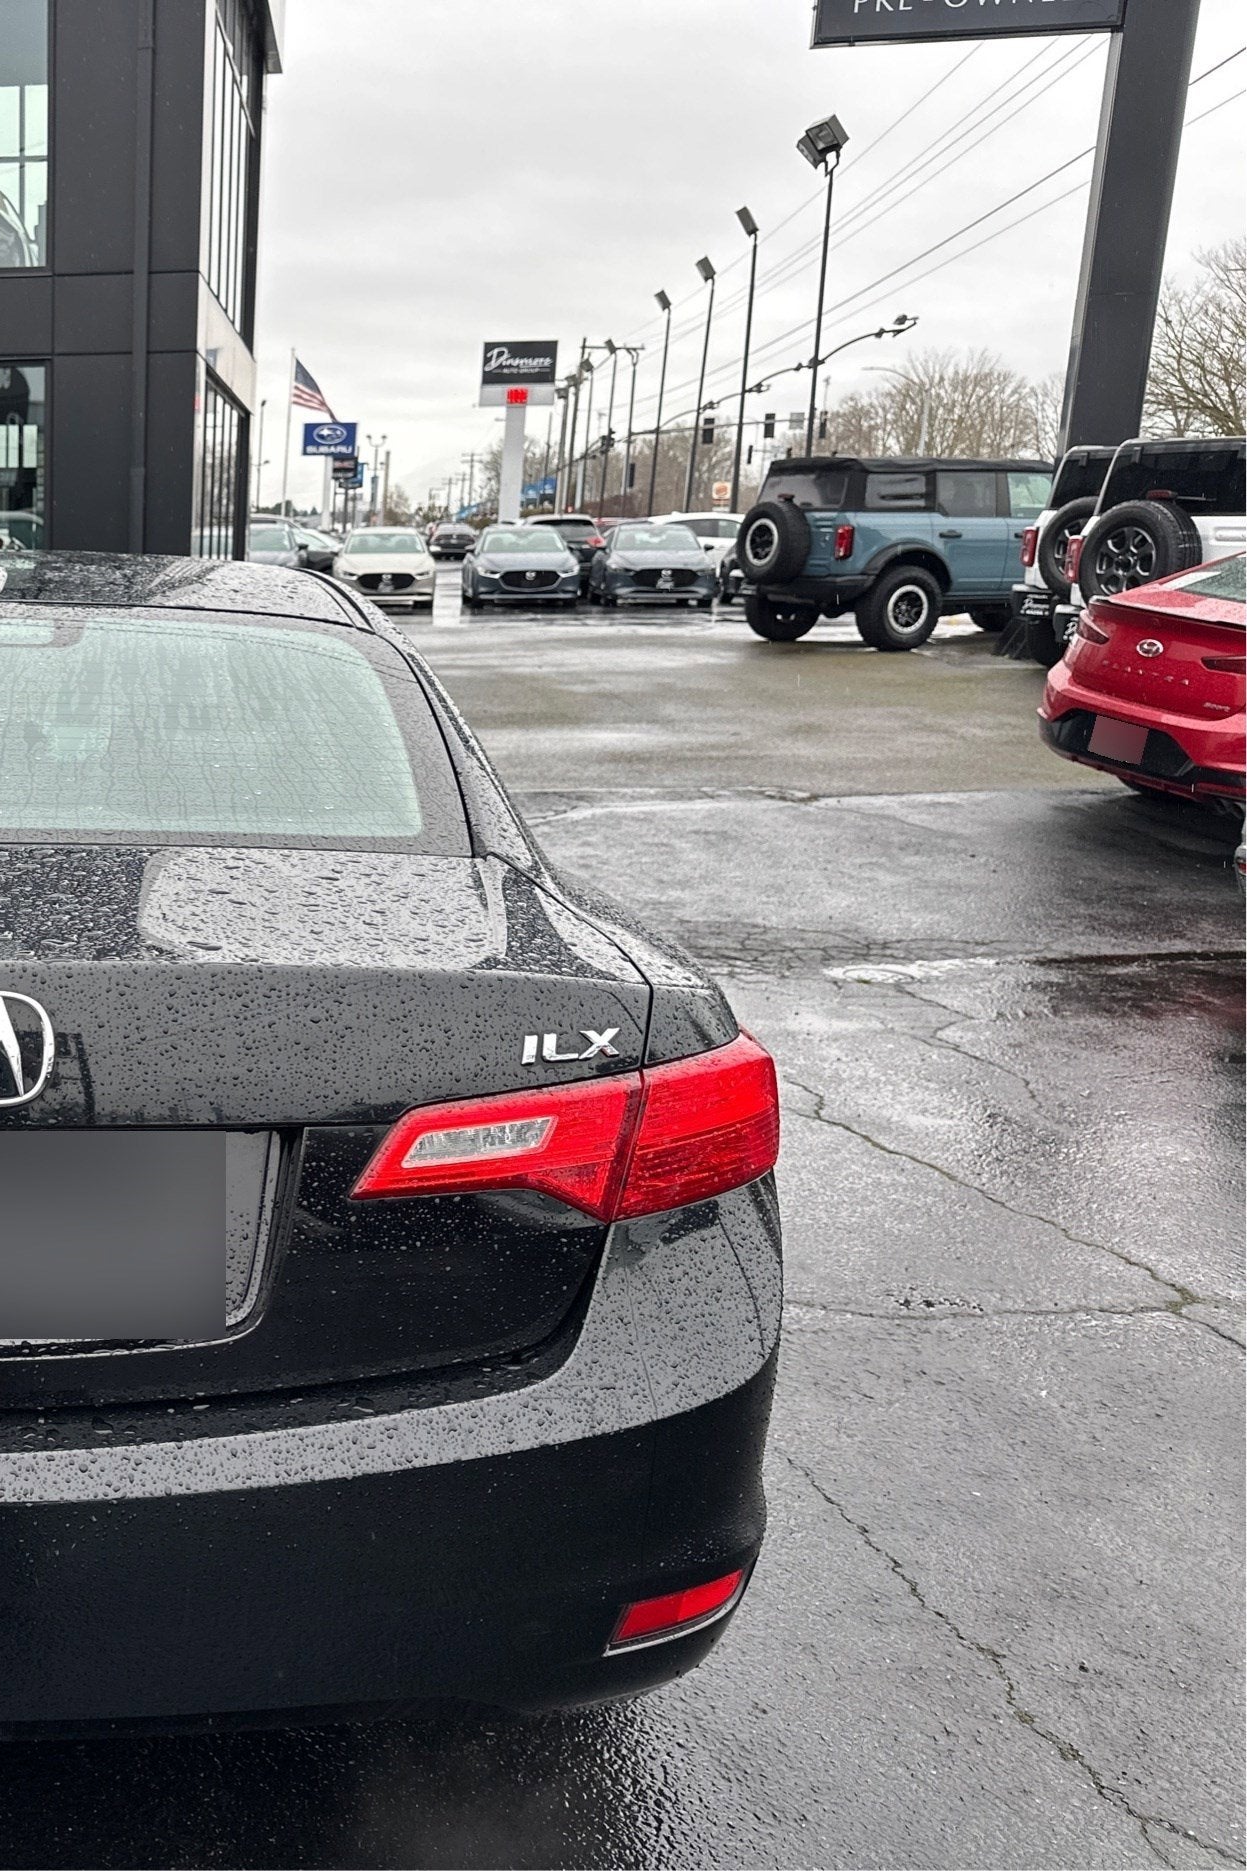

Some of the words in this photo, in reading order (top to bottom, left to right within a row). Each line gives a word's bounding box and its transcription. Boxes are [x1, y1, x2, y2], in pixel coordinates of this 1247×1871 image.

[853, 0, 1073, 13] PRE-O
[306, 445, 352, 454] SUBARU
[521, 1027, 621, 1066] ILX
